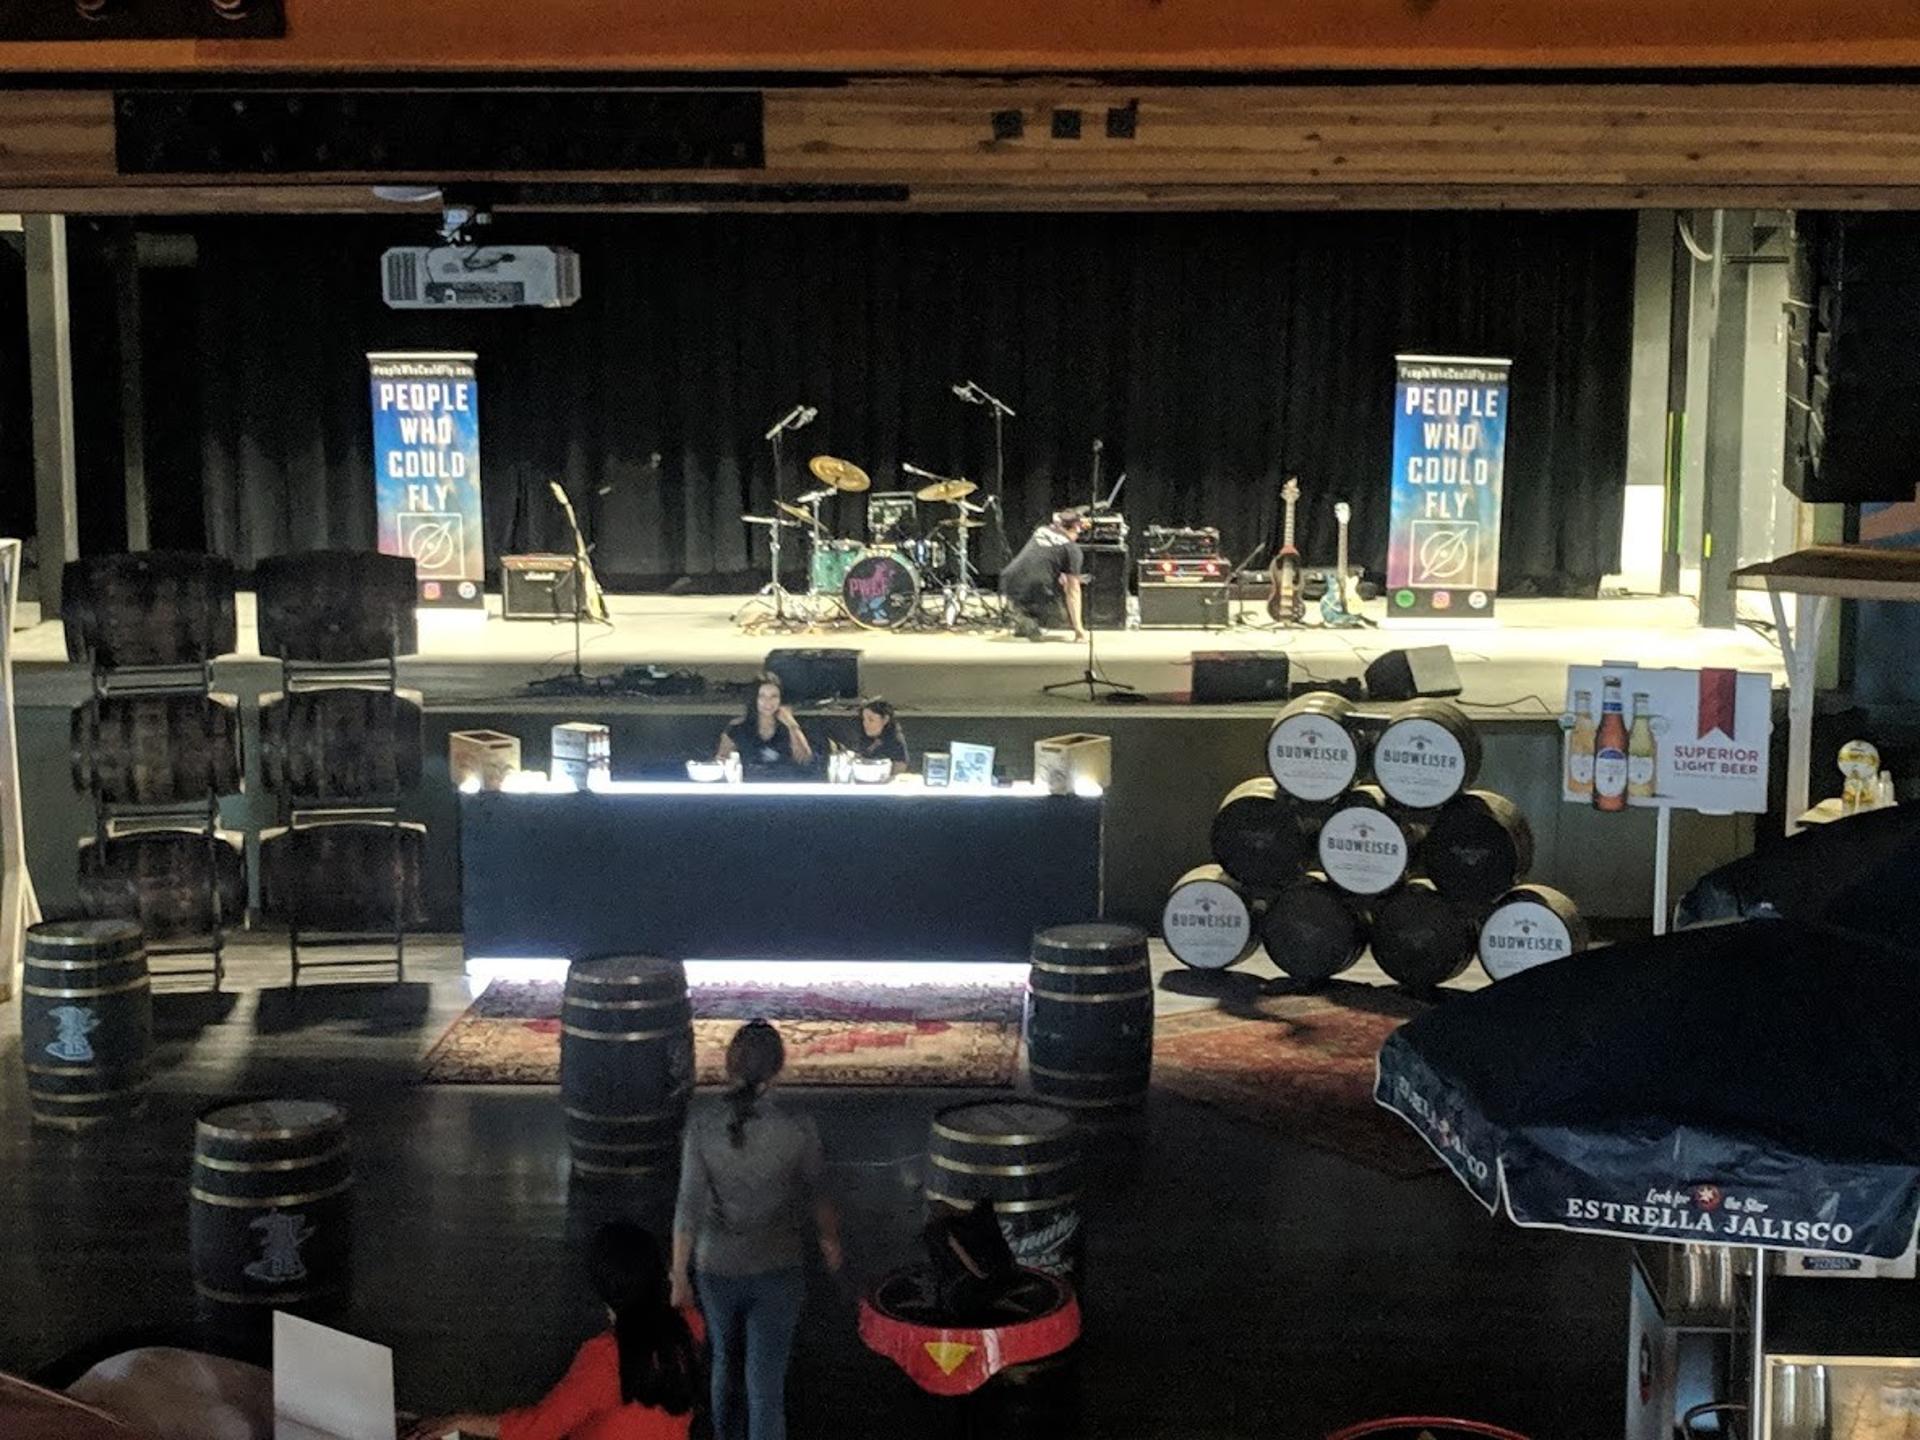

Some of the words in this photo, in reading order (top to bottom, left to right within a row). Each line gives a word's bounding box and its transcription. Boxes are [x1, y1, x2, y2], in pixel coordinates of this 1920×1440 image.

[380, 383, 469, 411] PEOPLE
[1405, 387, 1499, 417] PEOPLE
[400, 417, 452, 444] WHO
[1423, 422, 1479, 450] WHO
[388, 451, 466, 478] COULD
[1408, 457, 1488, 485] COULD
[408, 484, 449, 512] FLY
[1425, 492, 1468, 518] FLY
[1276, 744, 1349, 762] BUDWEISER
[1383, 749, 1457, 768] BUDWEISER
[1674, 745, 1759, 761] SUPERIOR
[1674, 760, 1716, 772] LIGHT
[1721, 763, 1758, 774] BEER
[1327, 837, 1399, 856] BUDWEISER
[1172, 912, 1241, 928] BUDWEISER
[1488, 935, 1563, 951] BUDWEISER
[1566, 1198, 1715, 1233] ESTRELLA
[1724, 1214, 1853, 1244] JALISCO
